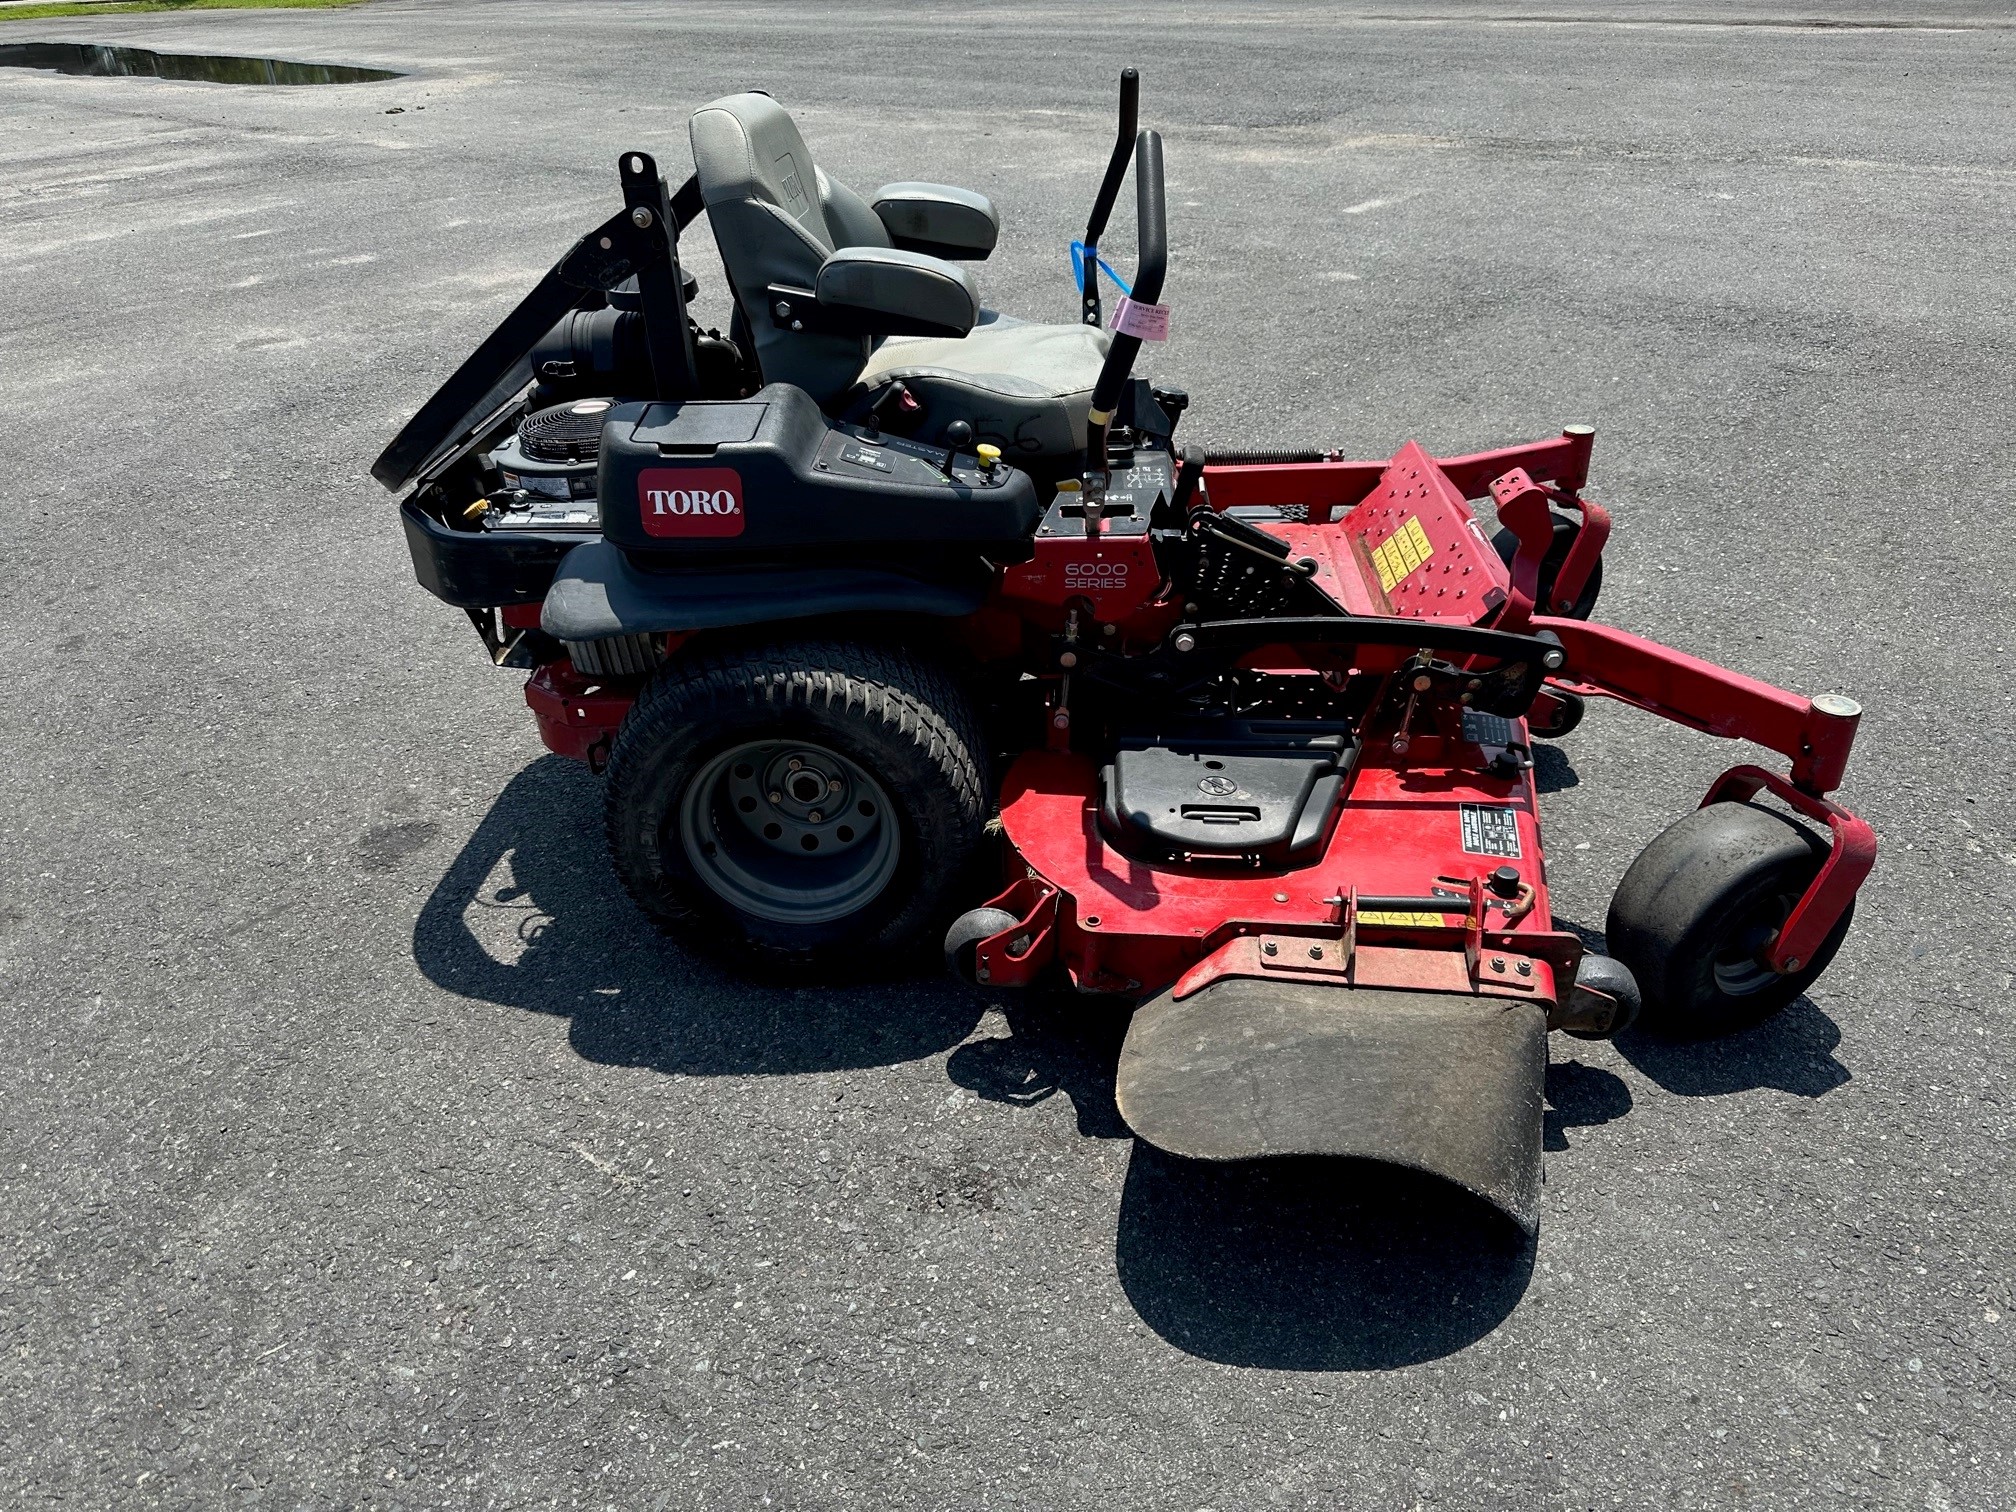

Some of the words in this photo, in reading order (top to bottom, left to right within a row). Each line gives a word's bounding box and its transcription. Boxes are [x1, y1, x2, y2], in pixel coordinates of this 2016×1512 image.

[646, 489, 736, 515] TORO
[1065, 563, 1128, 576] 6000
[1064, 578, 1127, 588] SERIES
